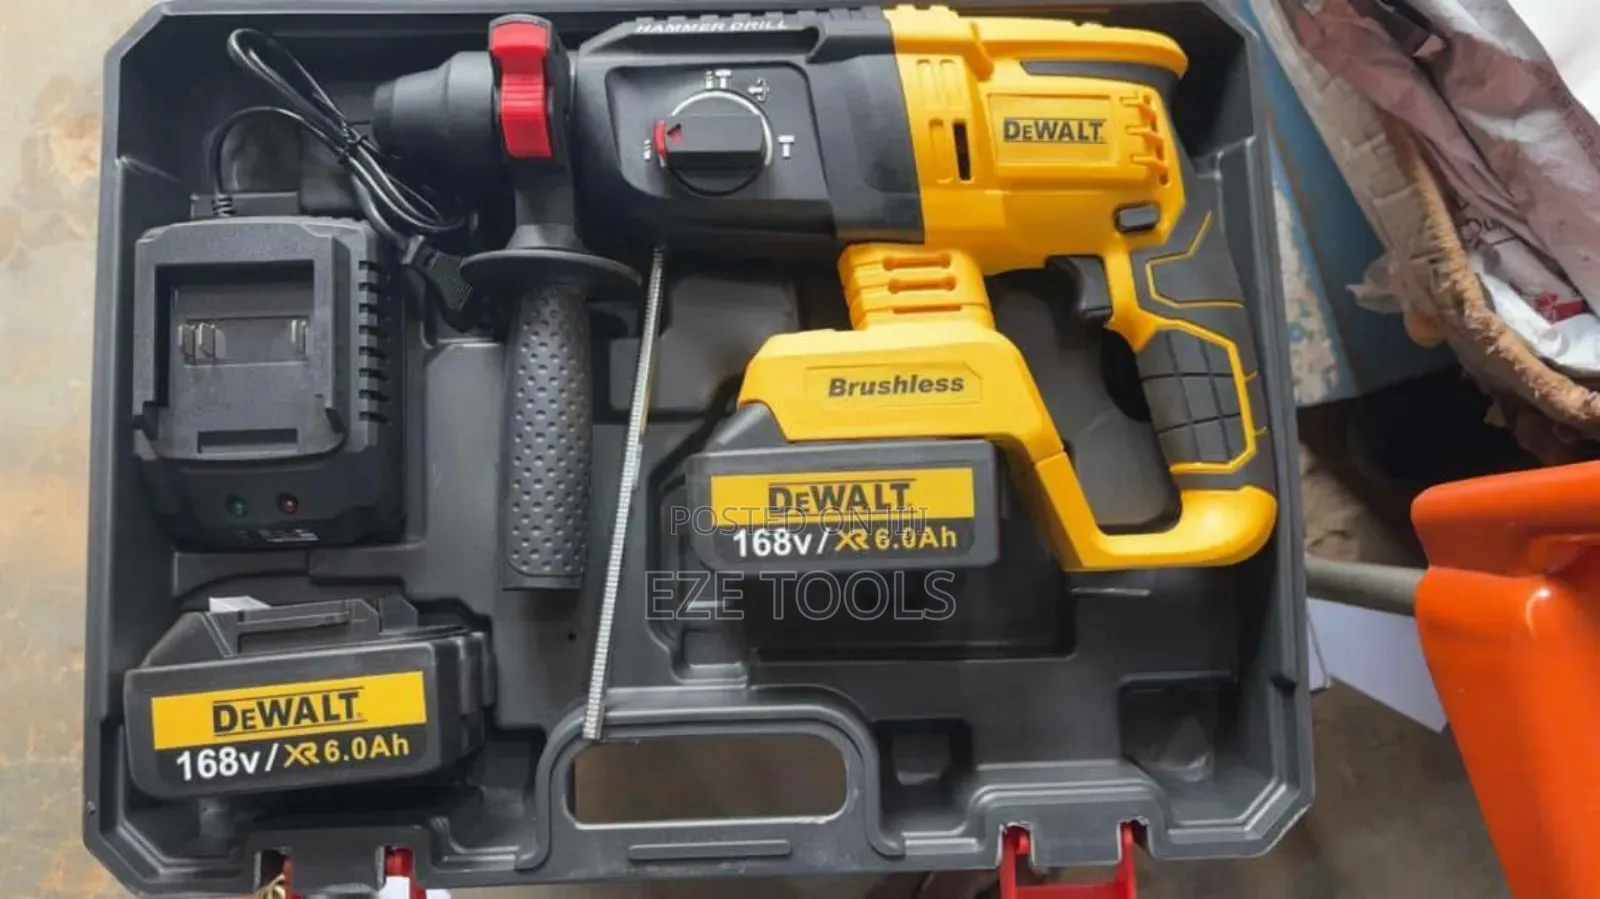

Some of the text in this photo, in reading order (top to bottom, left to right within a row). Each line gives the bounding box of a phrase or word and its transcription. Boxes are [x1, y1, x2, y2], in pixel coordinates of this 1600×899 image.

[635, 19, 787, 33] HAMMER DRILL
[828, 374, 965, 398] Brushless
